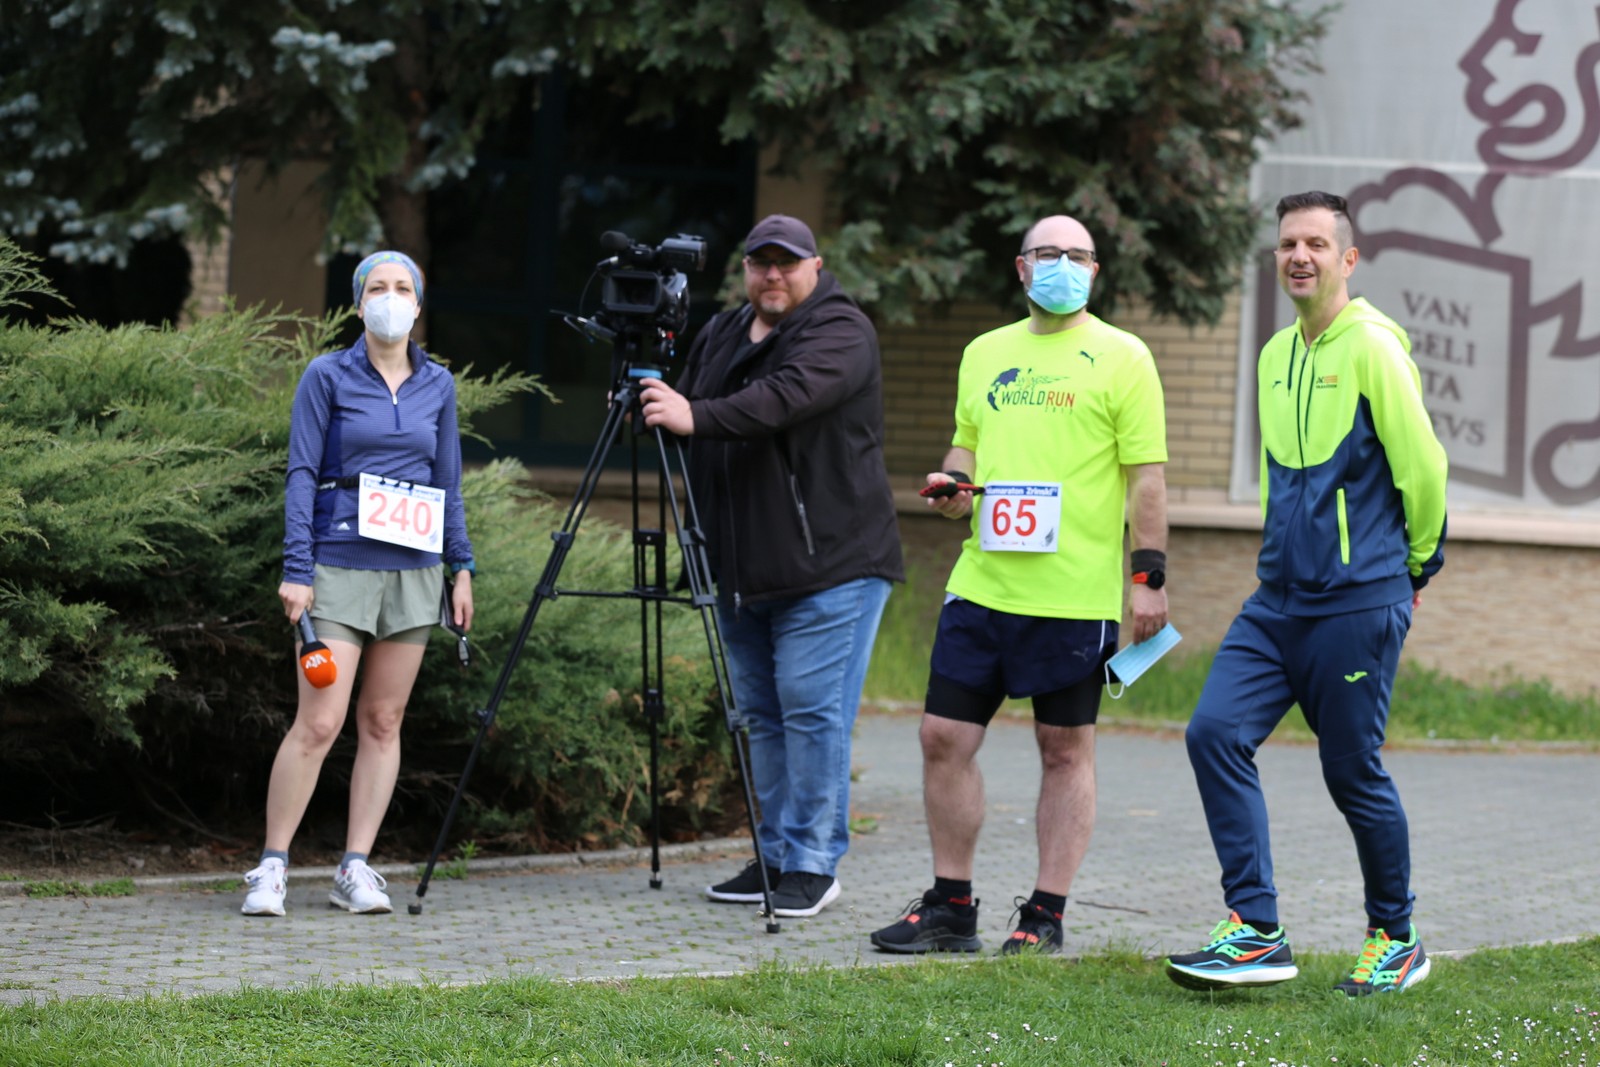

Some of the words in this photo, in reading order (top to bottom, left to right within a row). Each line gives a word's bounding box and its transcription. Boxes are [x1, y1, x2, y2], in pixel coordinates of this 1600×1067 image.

[1402, 290, 1470, 328] VAN
[1419, 366, 1462, 402] TA
[367, 492, 432, 536] 240
[992, 498, 1037, 537] 65
